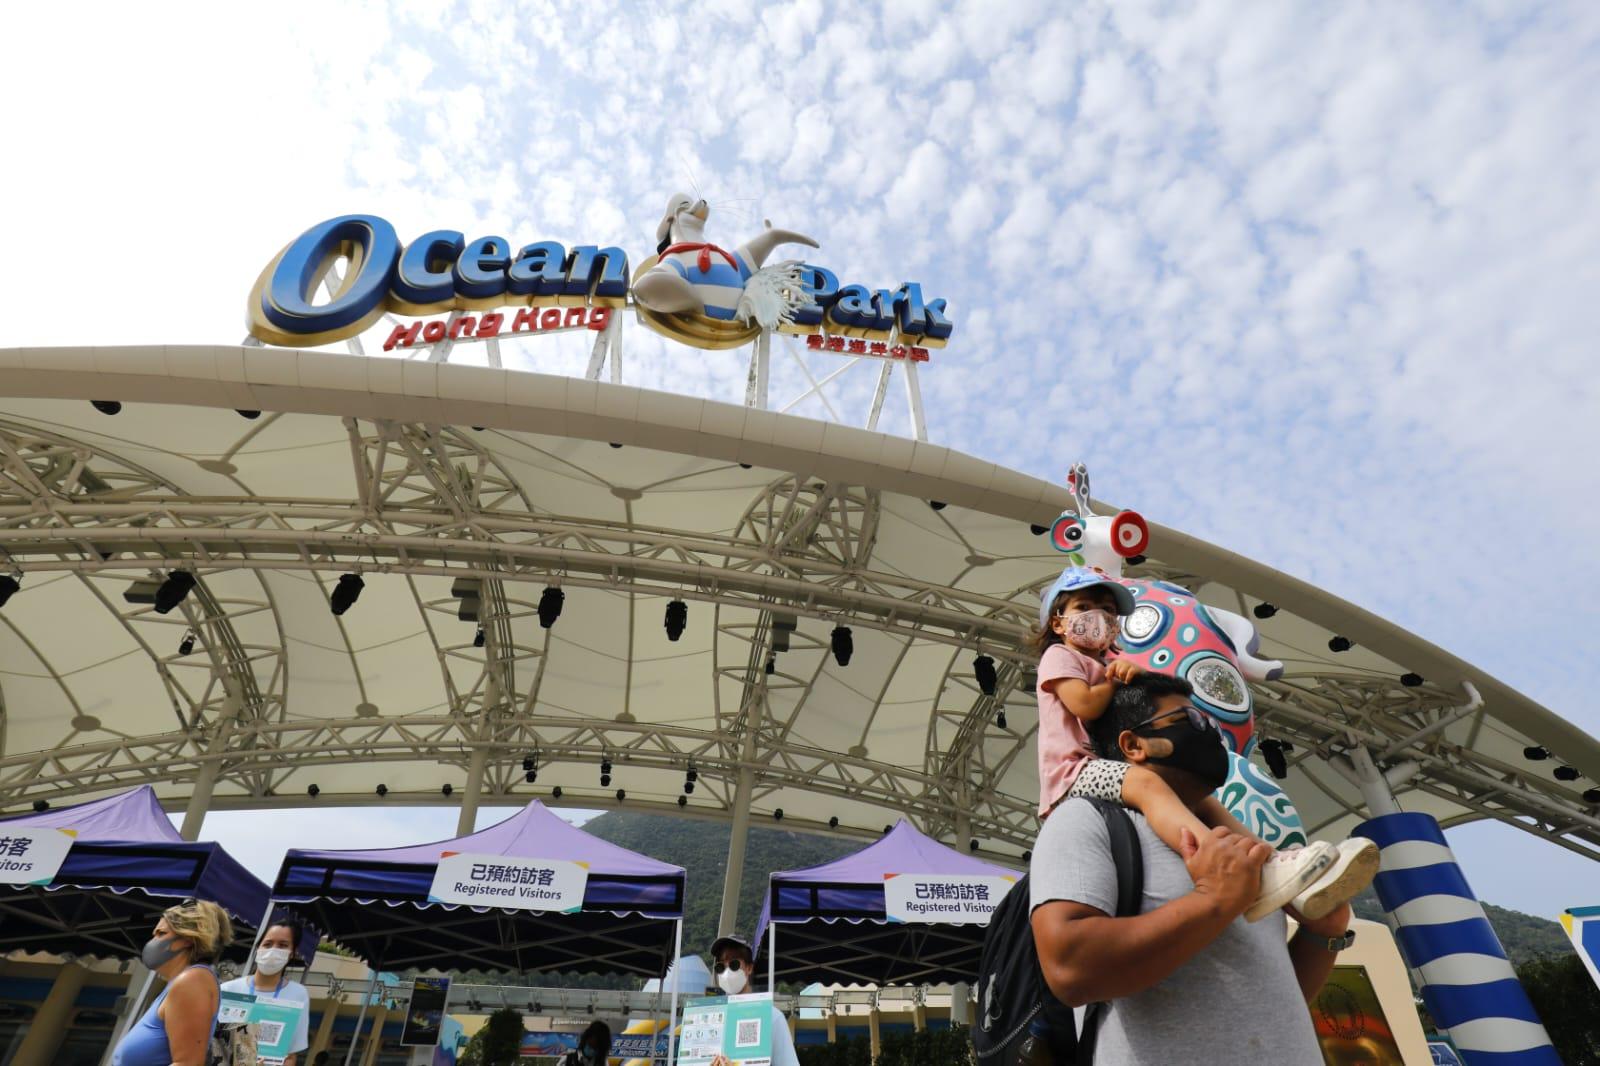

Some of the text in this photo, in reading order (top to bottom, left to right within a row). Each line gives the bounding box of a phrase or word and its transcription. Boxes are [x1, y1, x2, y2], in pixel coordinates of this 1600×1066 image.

[262, 214, 953, 338] Ocean Park
[383, 304, 612, 351] Hong Kong
[0, 859, 33, 871] itors
[470, 863, 555, 886] 已預約訪客
[454, 882, 562, 900] Registered Visitors
[914, 883, 989, 901] 已預約訪客
[906, 901, 996, 914] Registered Visitor
